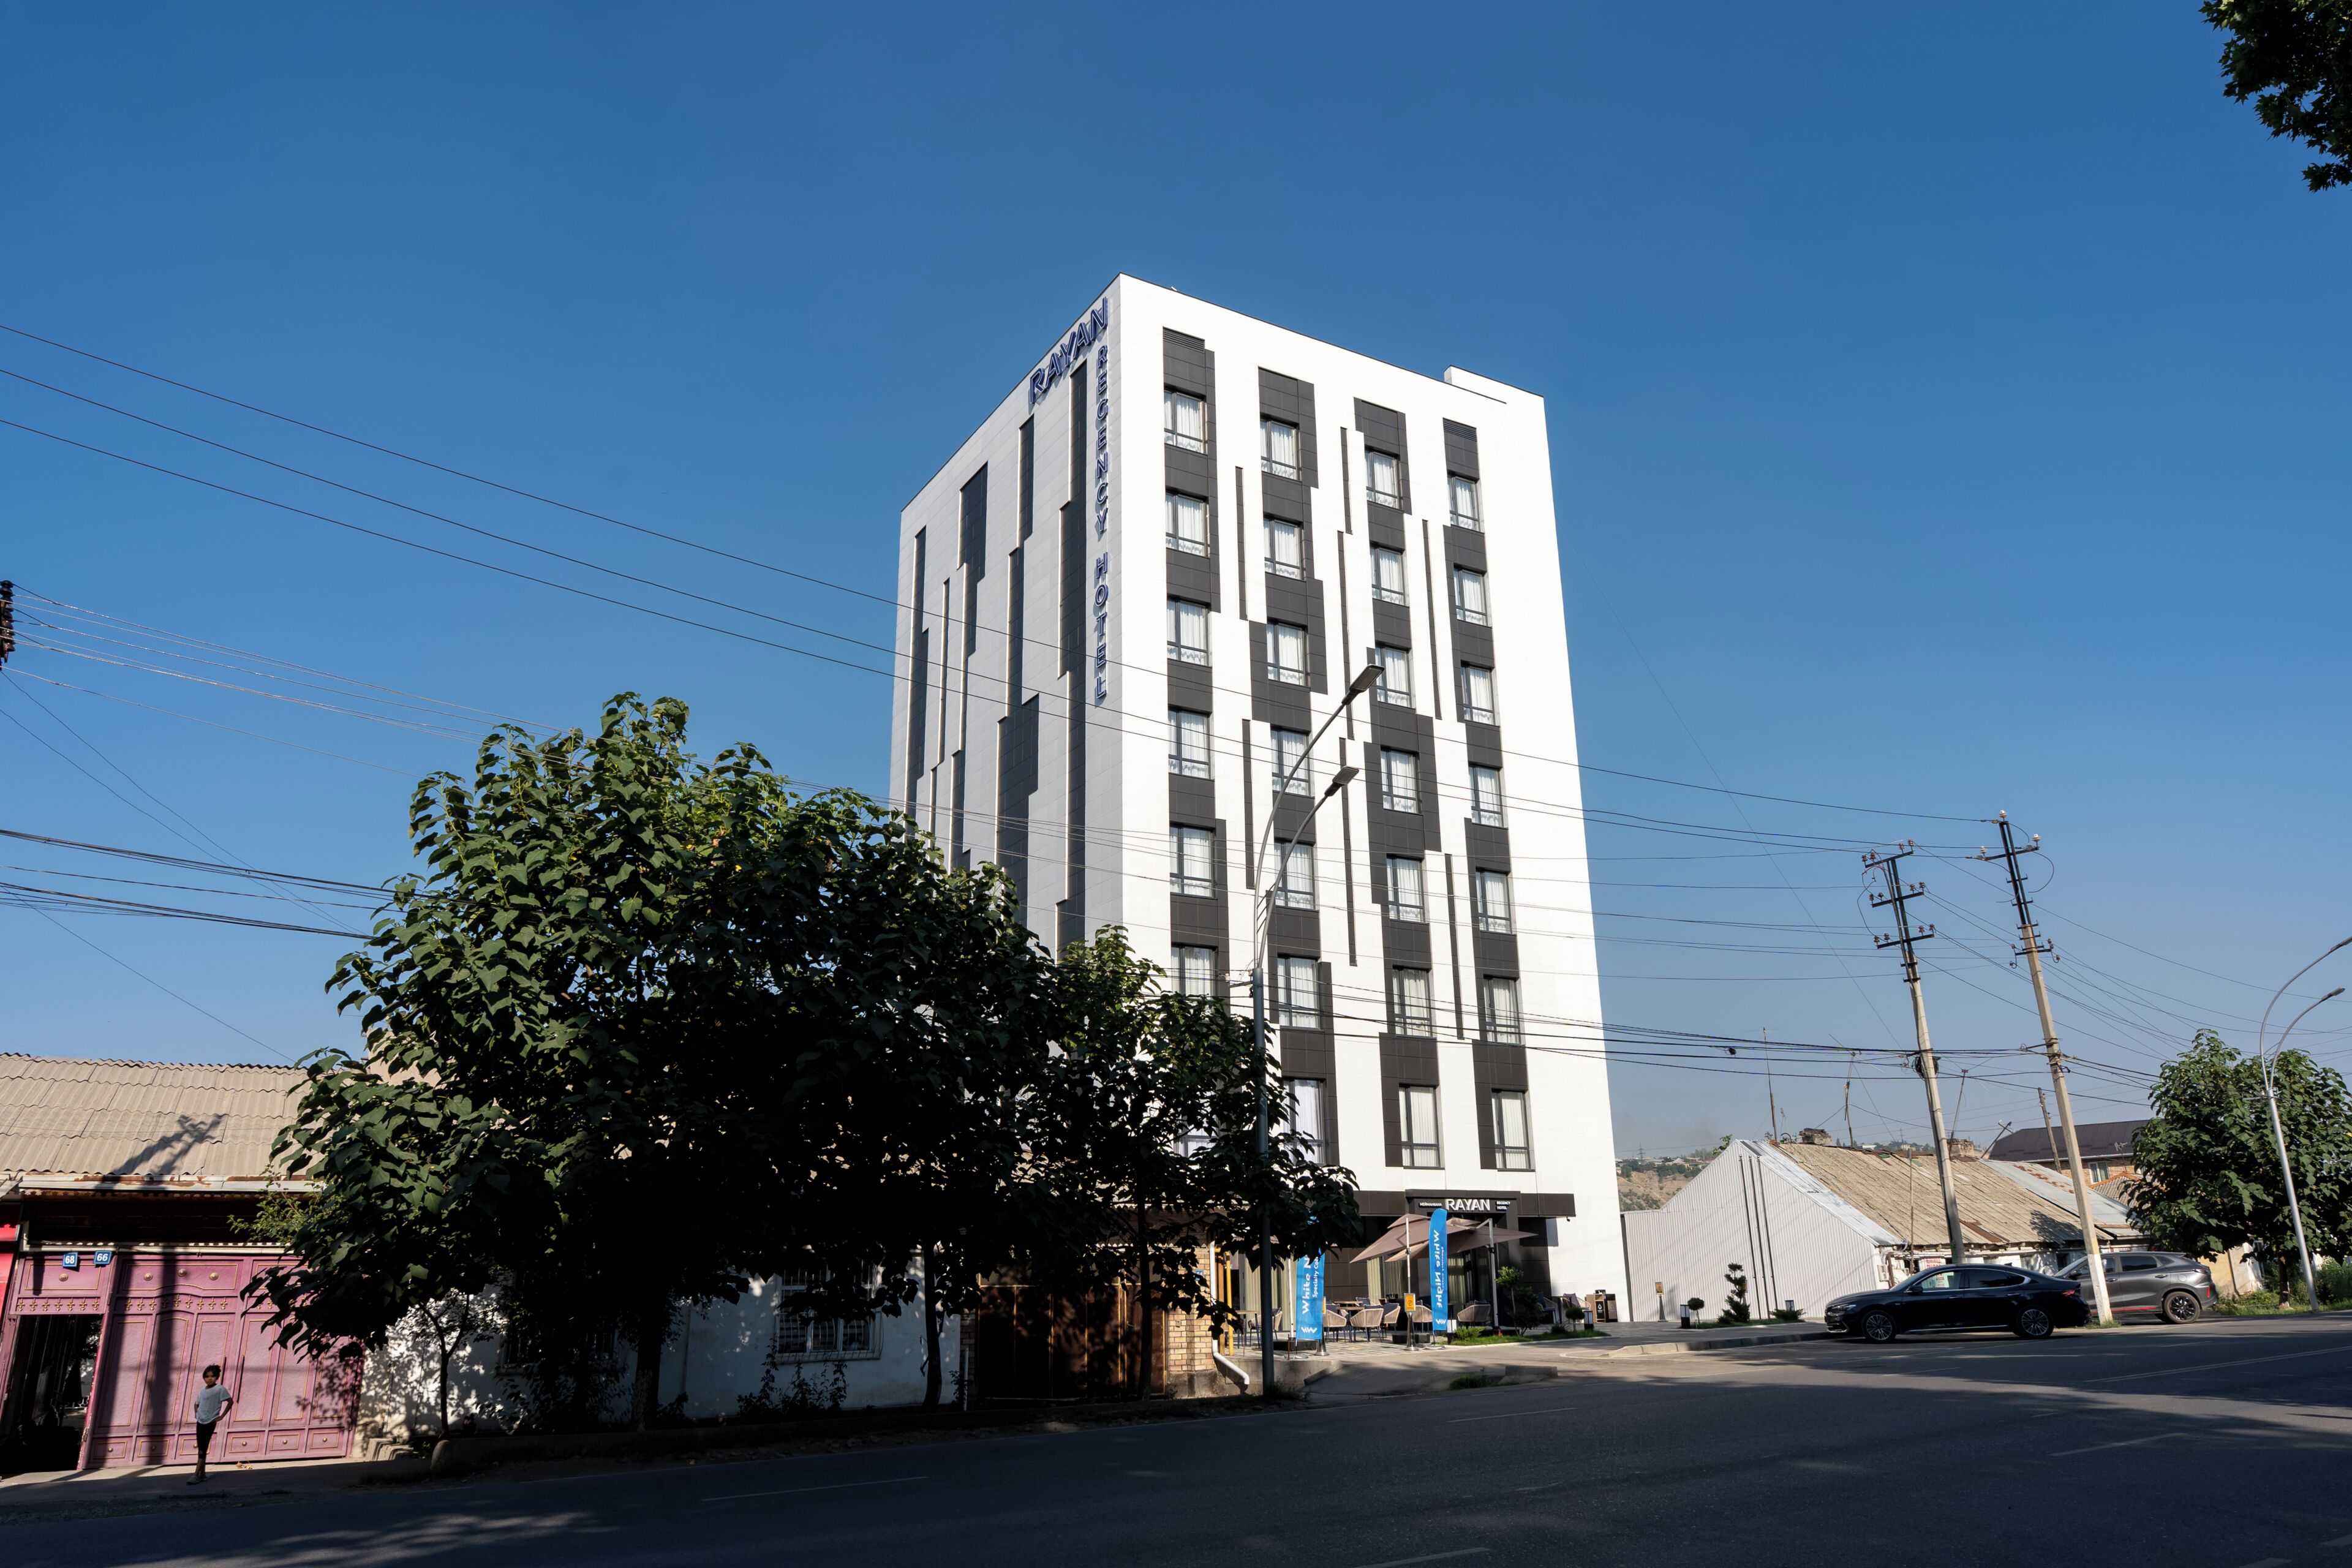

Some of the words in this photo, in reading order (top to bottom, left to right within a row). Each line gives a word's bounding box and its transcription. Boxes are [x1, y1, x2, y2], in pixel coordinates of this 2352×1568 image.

[1029, 296, 1109, 405] RAYAN
[1096, 345, 1109, 533] REGENCY
[1095, 552, 1109, 699] HOTEL
[1446, 1199, 1490, 1210] RAYAN
[65, 1255, 75, 1264] 68
[1302, 1273, 1311, 1314] White
